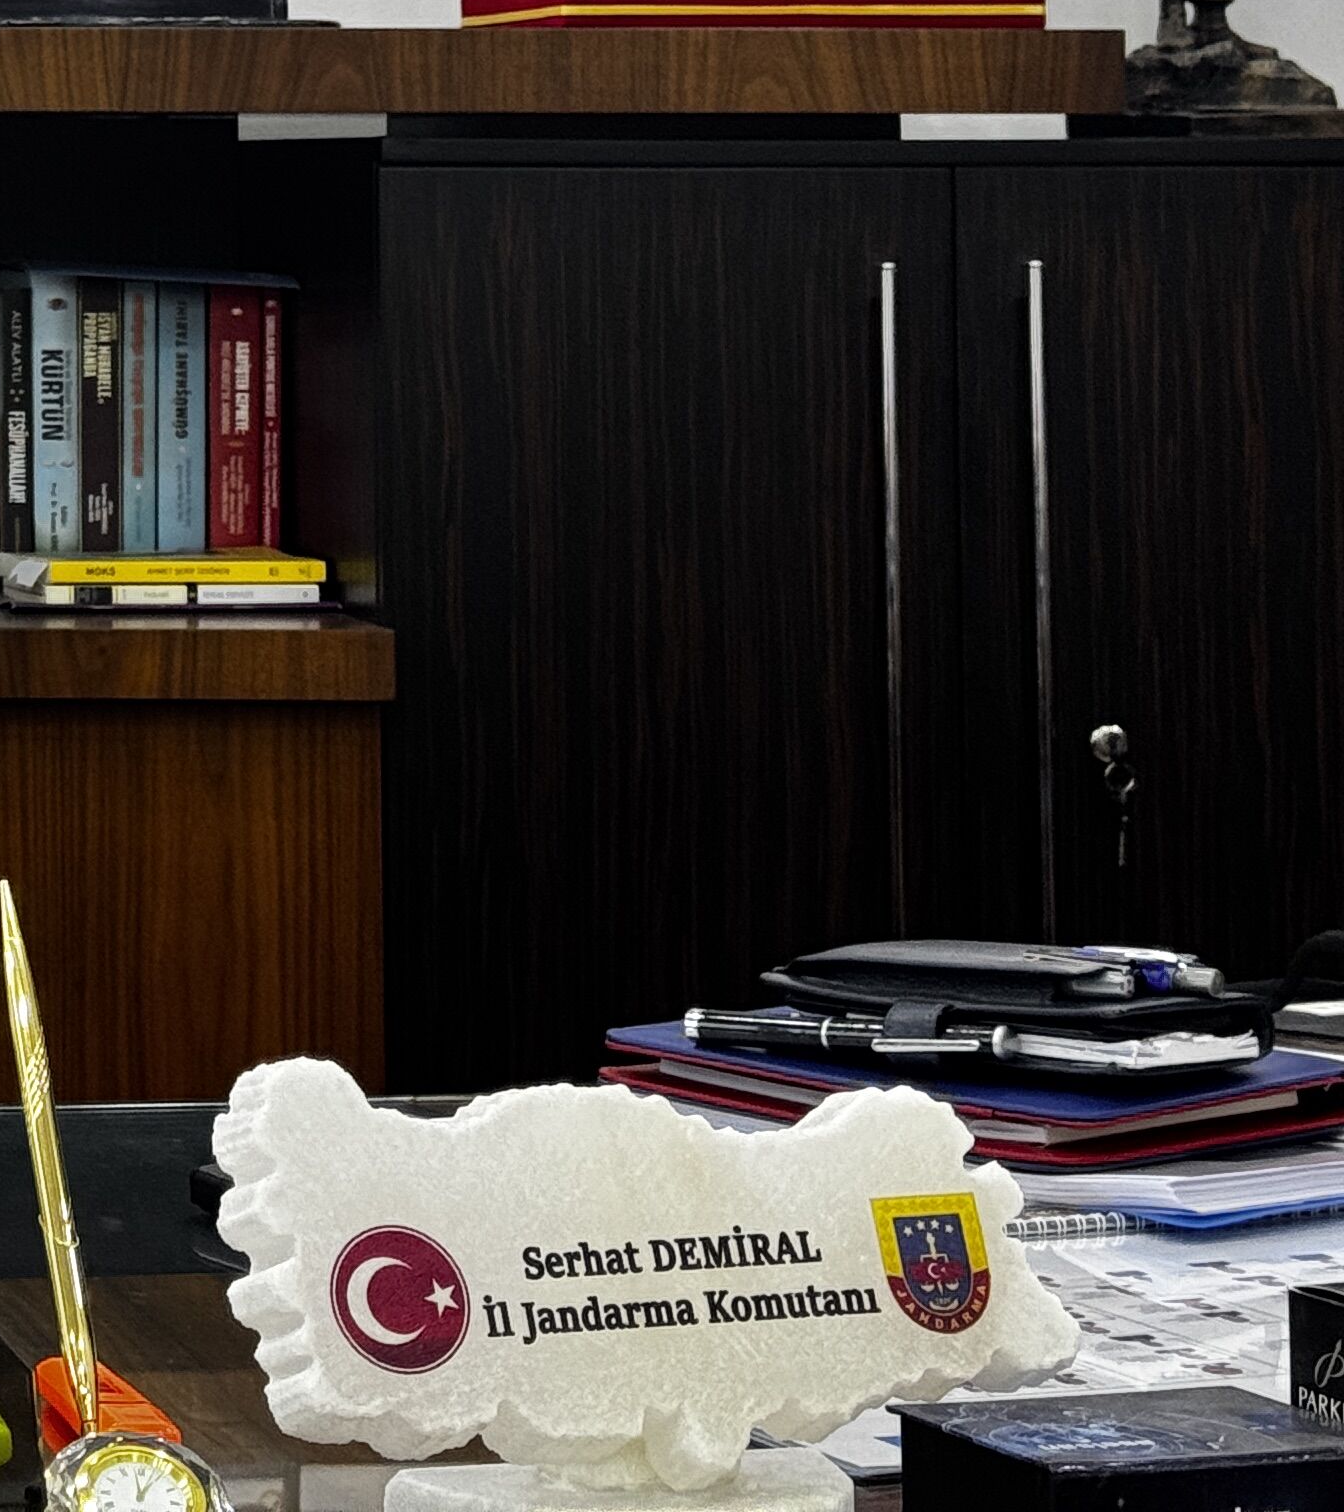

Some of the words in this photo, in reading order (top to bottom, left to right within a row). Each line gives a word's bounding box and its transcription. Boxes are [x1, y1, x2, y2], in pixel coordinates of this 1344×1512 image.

[522, 1241, 643, 1280] Serhat
[648, 1225, 823, 1273] DEMİRAL
[483, 1294, 516, 1338] İl
[521, 1295, 700, 1346] Jandarma
[703, 1285, 883, 1325] Komutanı
[896, 1284, 987, 1330] JANDARMA
[1298, 1385, 1344, 1425] PARK
